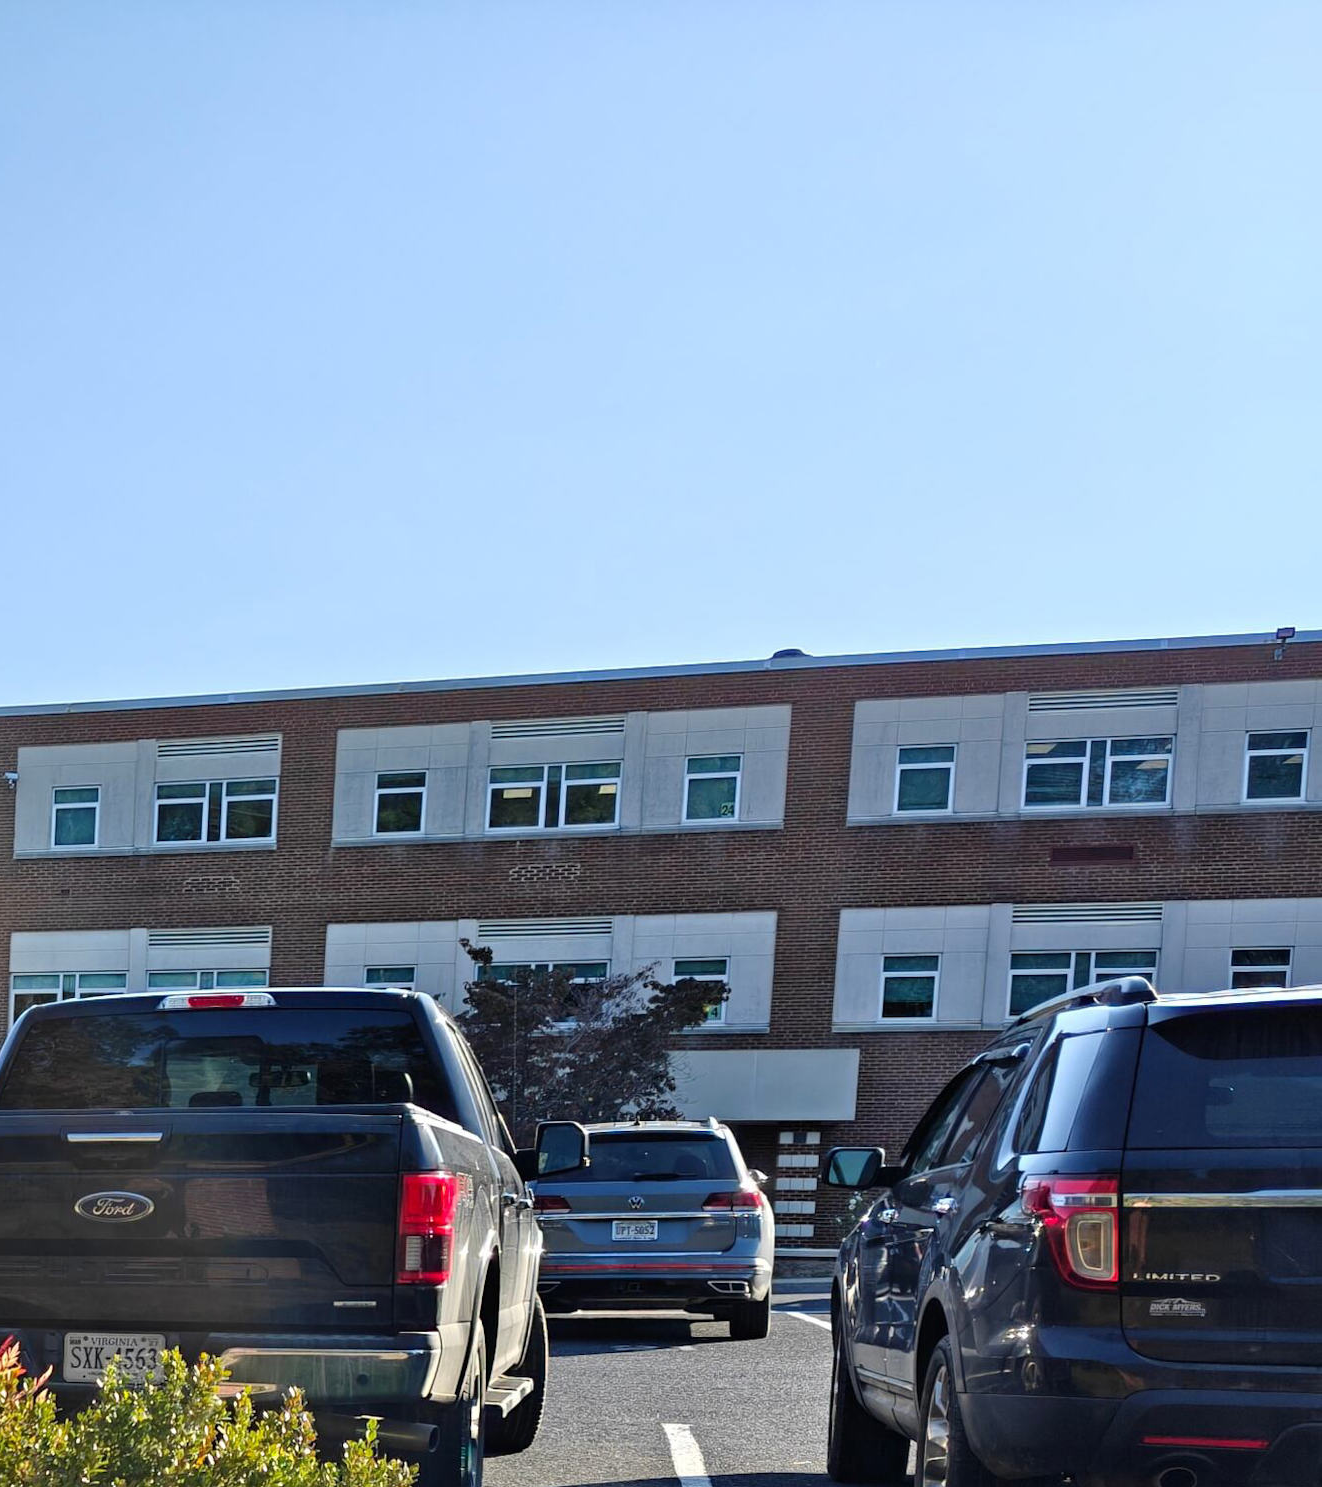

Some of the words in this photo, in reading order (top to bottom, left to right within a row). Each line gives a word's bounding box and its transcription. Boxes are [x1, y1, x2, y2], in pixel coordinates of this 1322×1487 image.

[92, 1197, 136, 1216] Ford
[1132, 1271, 1221, 1282] LIMITED
[90, 1337, 138, 1347] VIRGINIA
